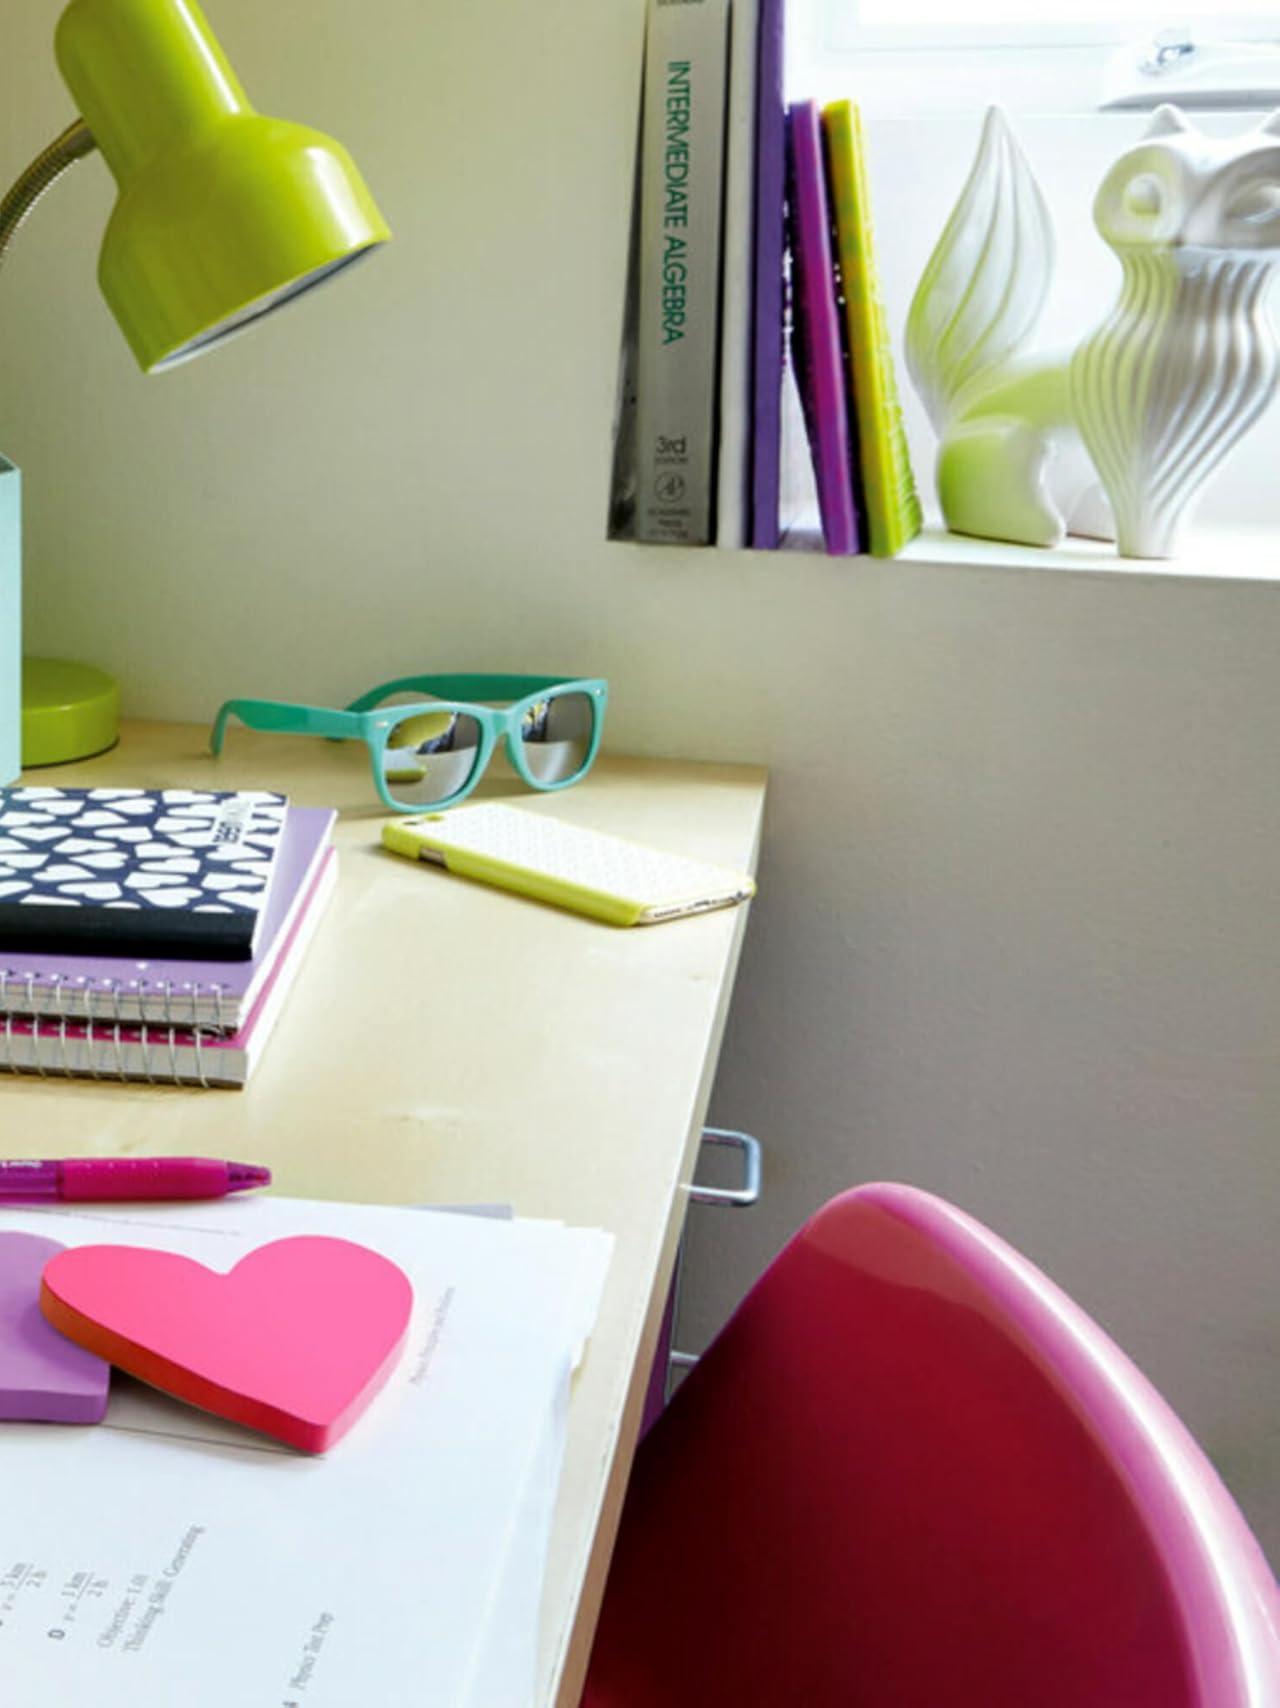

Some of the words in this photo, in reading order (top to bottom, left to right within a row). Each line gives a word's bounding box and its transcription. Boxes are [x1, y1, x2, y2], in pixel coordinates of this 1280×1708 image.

[661, 61, 691, 228] INTERMEDIATE
[660, 234, 688, 346] ALGEBRA
[656, 434, 687, 455] 3rd
